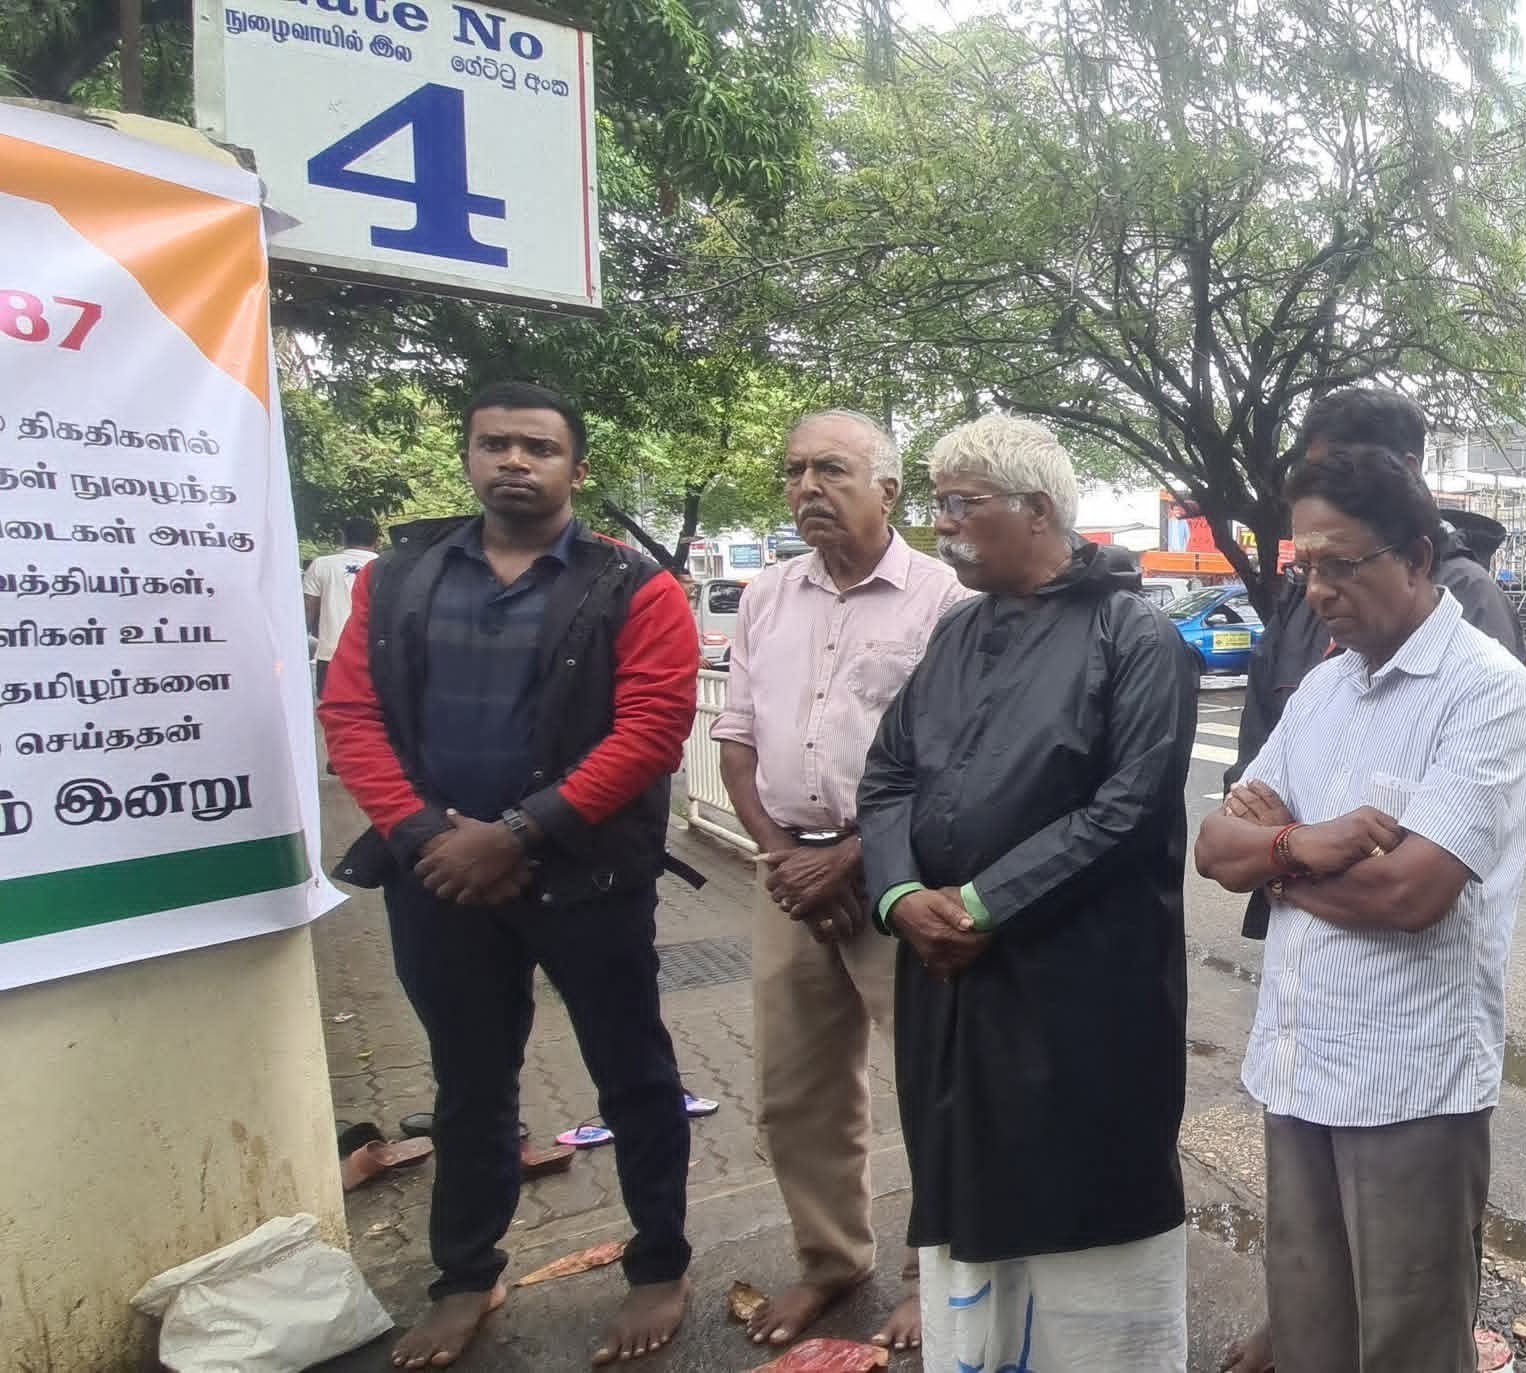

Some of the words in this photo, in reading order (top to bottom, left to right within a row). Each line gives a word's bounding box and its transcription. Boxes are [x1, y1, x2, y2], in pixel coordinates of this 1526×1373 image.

[225, 8, 363, 52] நுழைவாயில்
[370, 34, 413, 62] இல
[295, 0, 429, 32] ate
[453, 5, 544, 60] No
[525, 73, 570, 97] අංක
[307, 82, 508, 268] 4
[17, 411, 220, 455] திகதிகளில்
[70, 473, 237, 504] நுழைந்த
[0, 517, 137, 546] டைகள்
[149, 522, 255, 552] அங்கு
[120, 617, 228, 644] உட்பட
[0, 668, 232, 707] தமிழர்களை
[15, 714, 203, 756] செய்ததன்
[55, 772, 253, 827] இன்று
